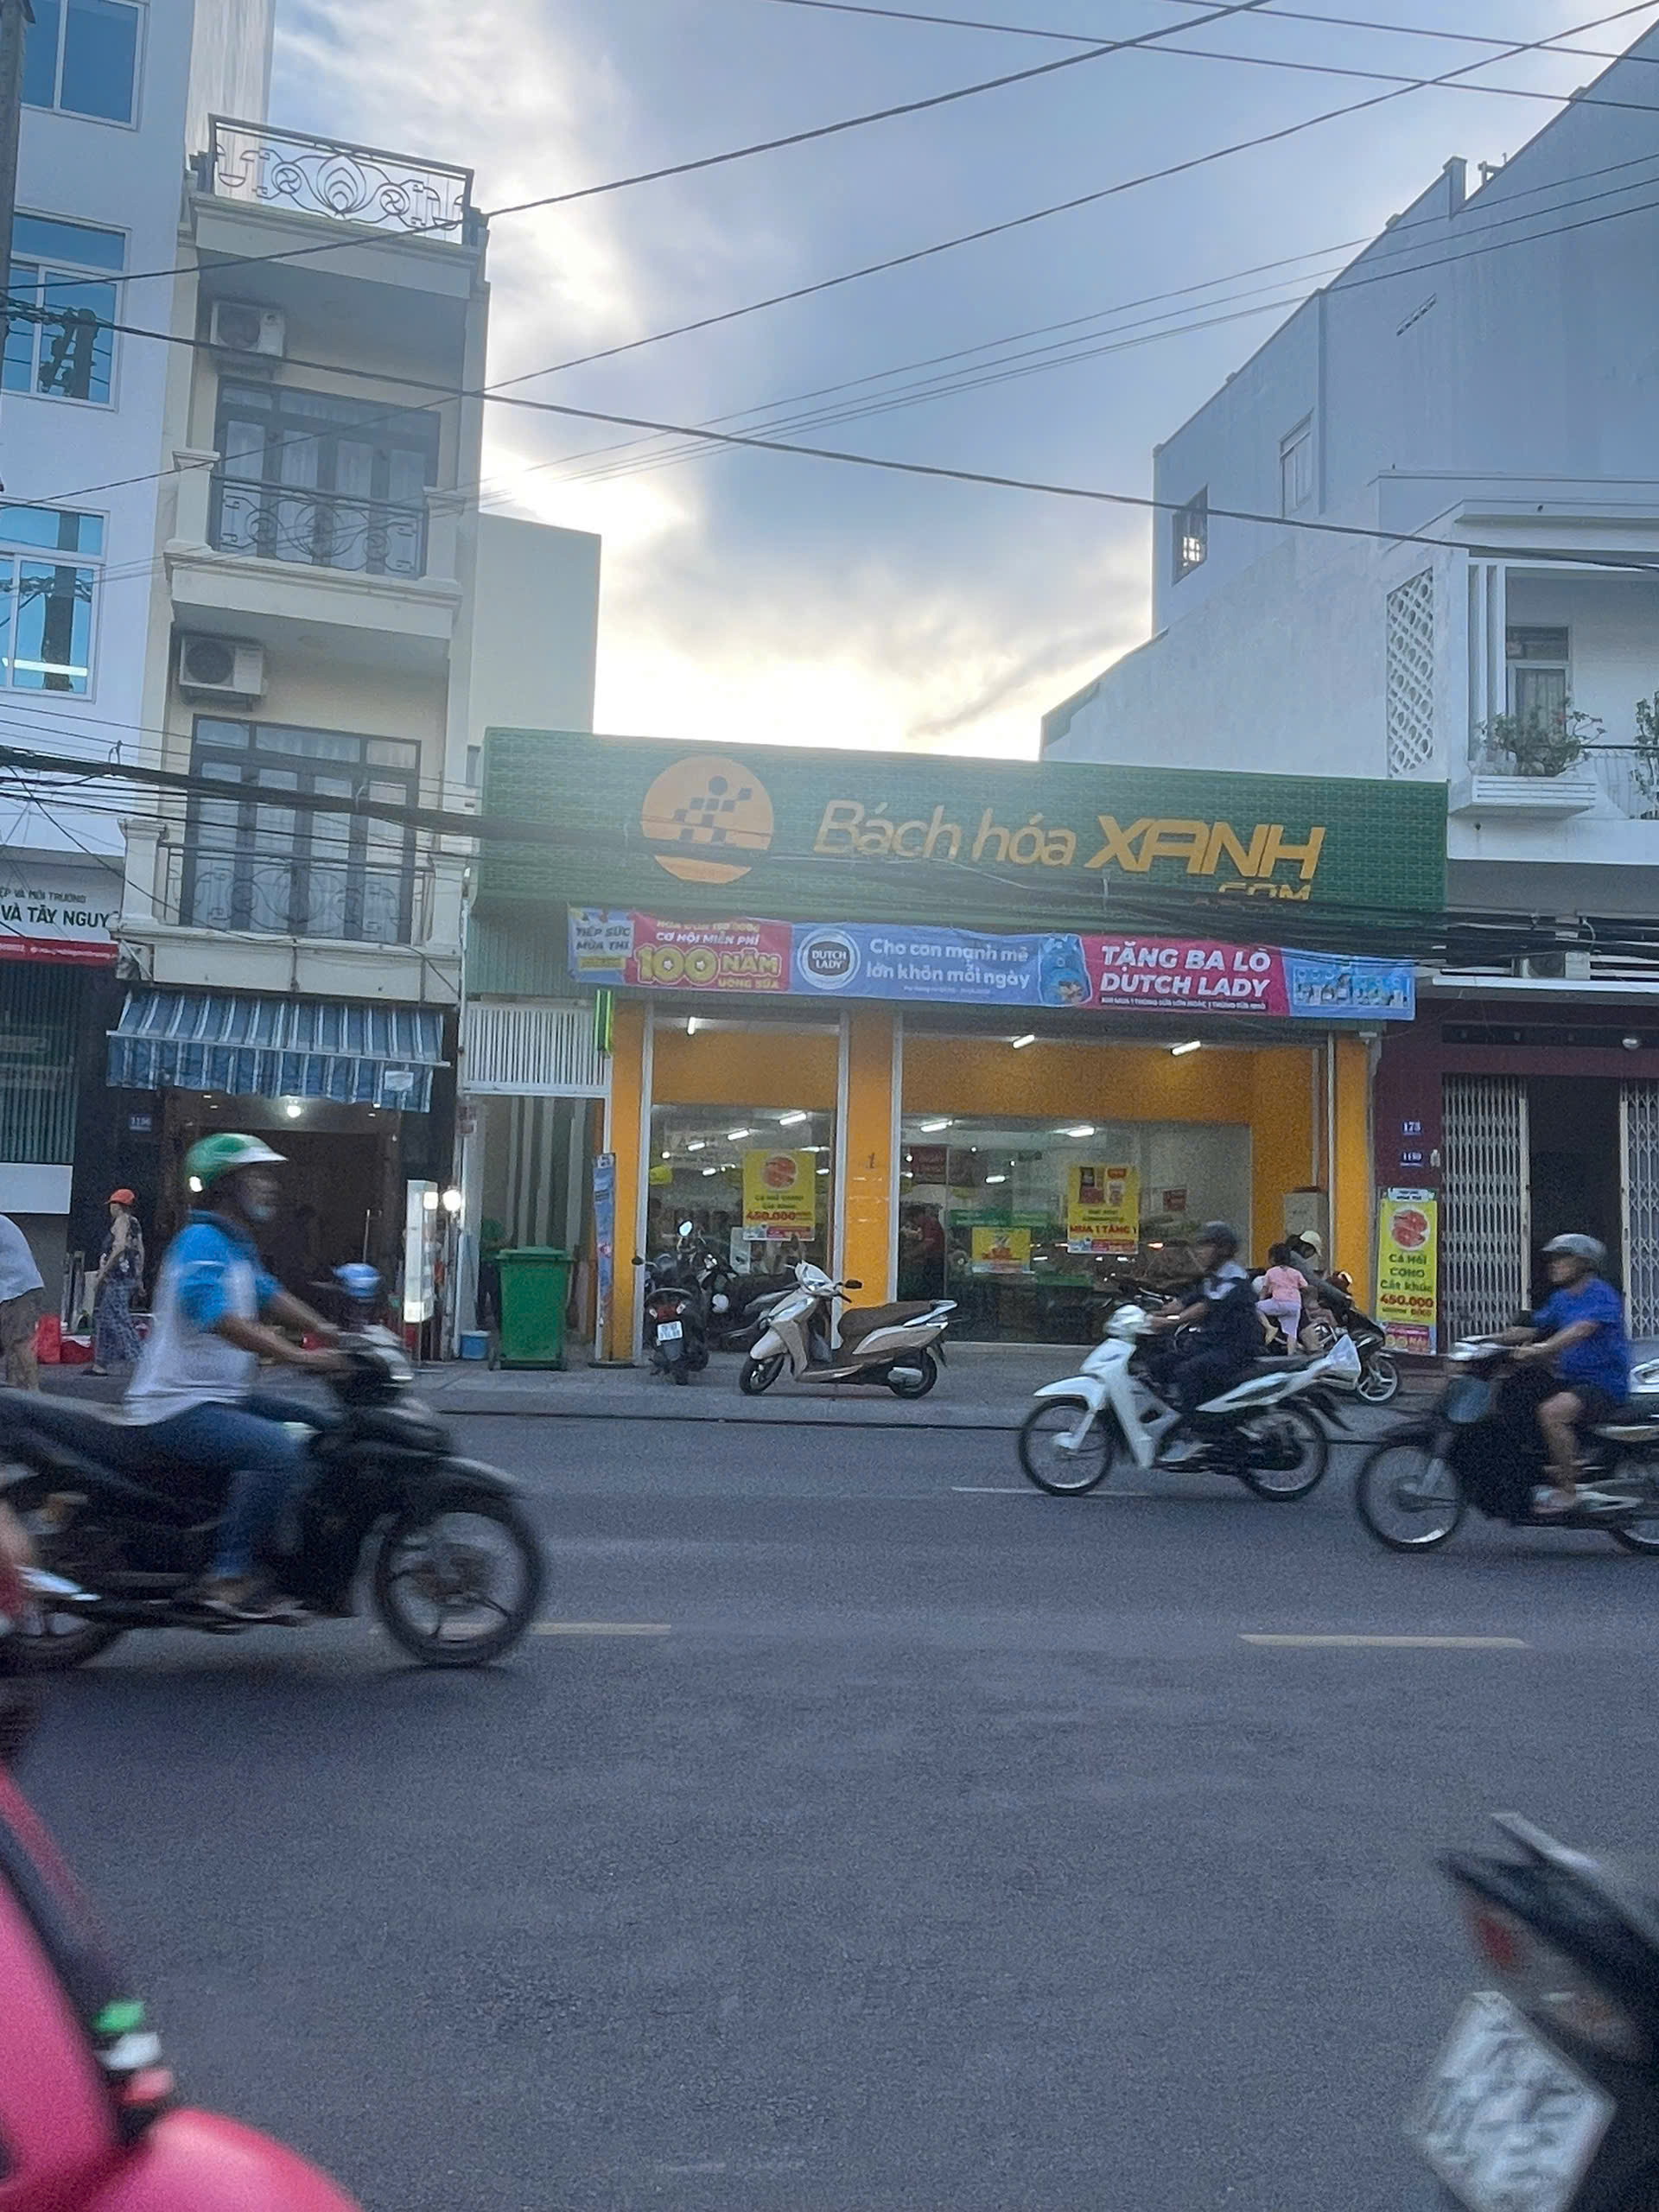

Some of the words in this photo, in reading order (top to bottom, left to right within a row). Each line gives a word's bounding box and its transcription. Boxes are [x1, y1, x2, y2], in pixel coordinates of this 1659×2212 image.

[814, 799, 962, 858] Bách
[972, 808, 1077, 866] hóa
[1084, 815, 1326, 880] XANH
[1, 902, 22, 922] VÀ
[27, 904, 57, 924] TÂY
[812, 950, 847, 960] DUTCH
[870, 938, 905, 957] Cho
[945, 944, 997, 963] mạnh
[1101, 941, 1179, 971] TẶNG
[1185, 950, 1225, 971] BA
[636, 944, 719, 986] 100
[721, 948, 781, 976] NĂM
[816, 959, 842, 969] LADY
[867, 961, 894, 978] lớn
[898, 963, 944, 982] khôn
[983, 970, 1030, 989] ngày
[1099, 972, 1192, 995] DUTCH
[1198, 976, 1270, 997] LADY
[1380, 1294, 1434, 1308] 450.000
